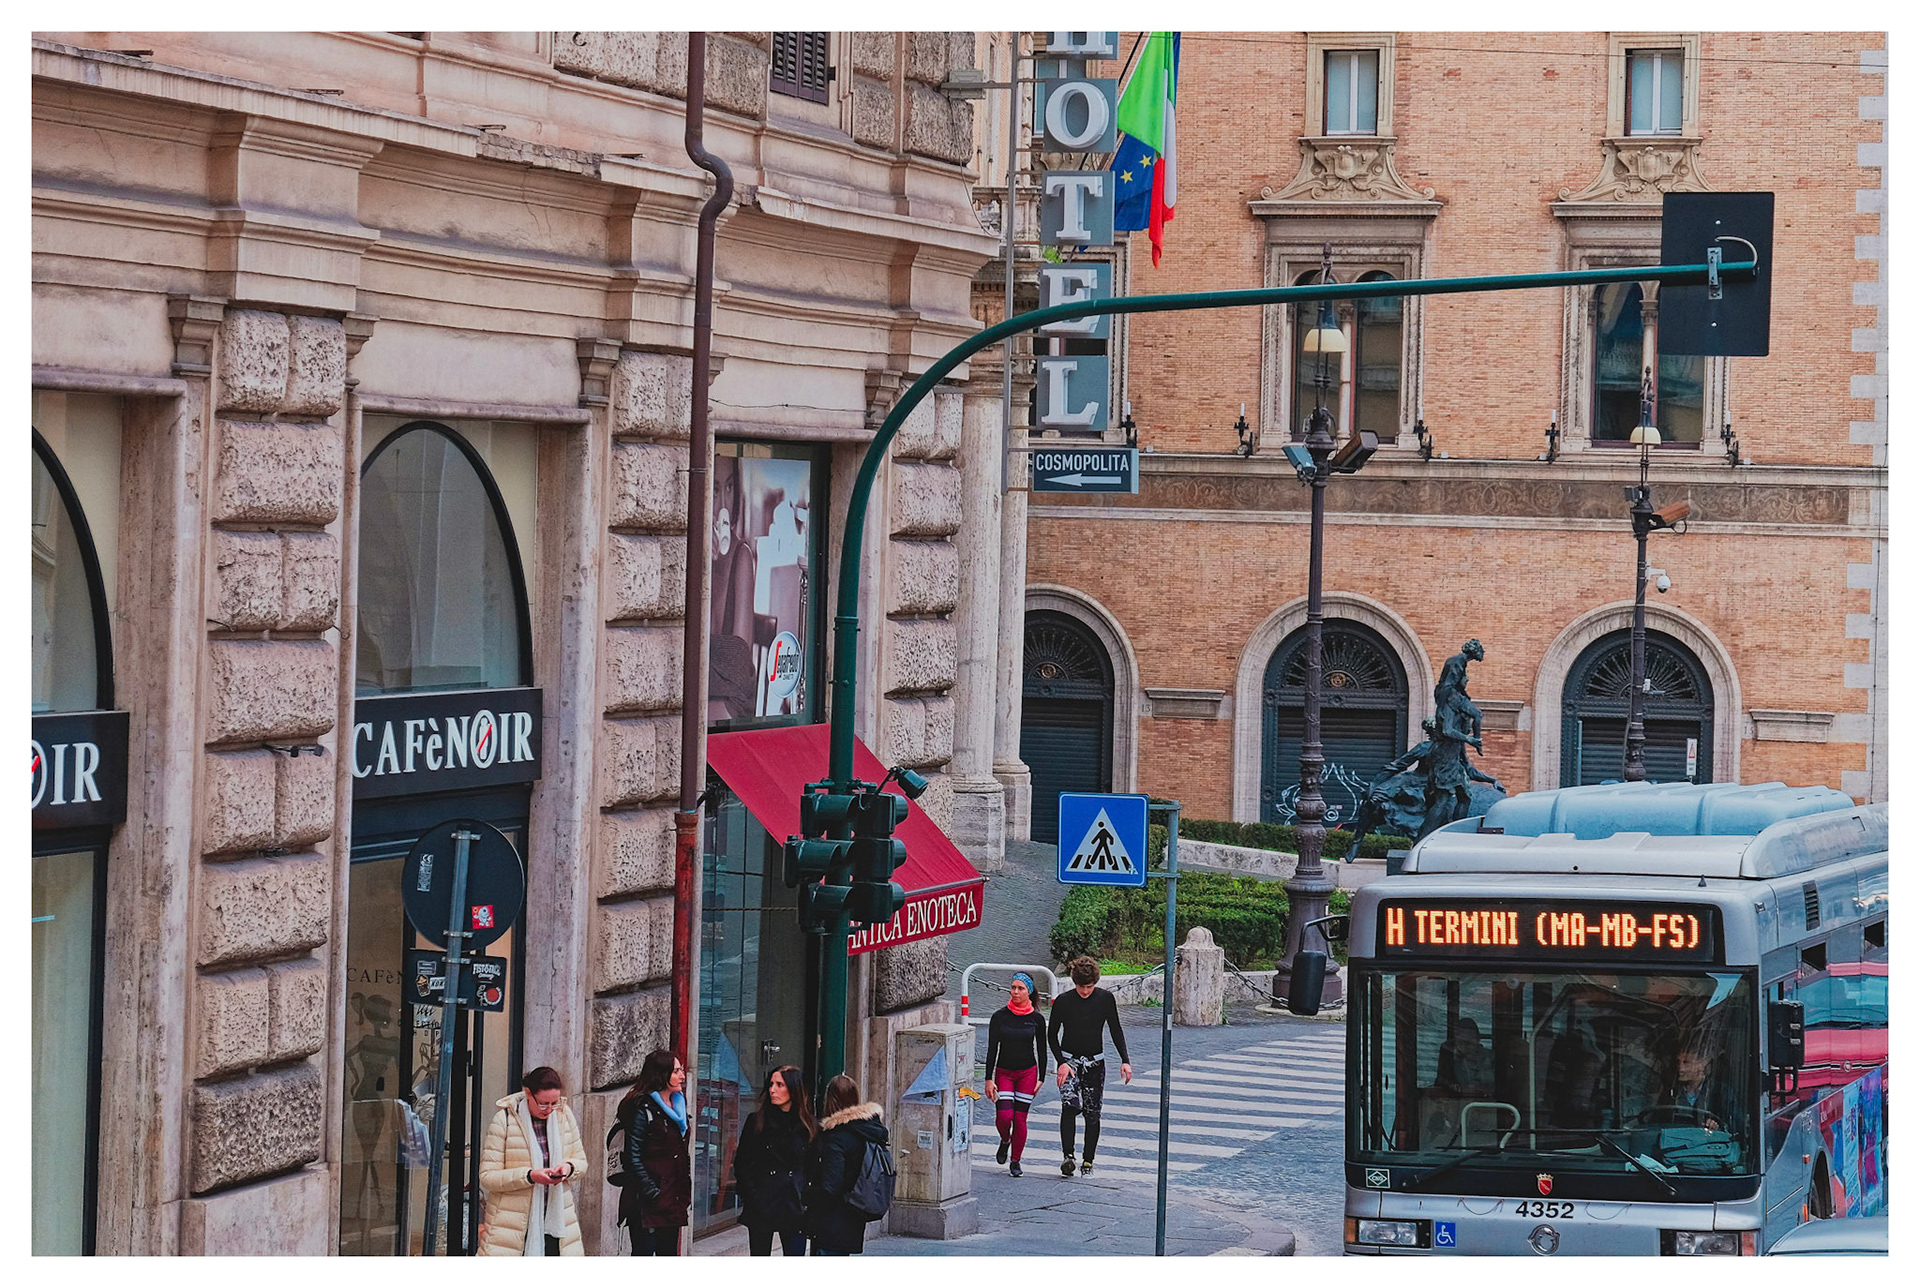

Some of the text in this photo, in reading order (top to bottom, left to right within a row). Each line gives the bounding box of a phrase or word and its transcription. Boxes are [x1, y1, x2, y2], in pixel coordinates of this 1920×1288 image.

[1036, 453, 1130, 471] COSMOPOLITA
[351, 709, 535, 778] CAFèNOIR
[906, 890, 977, 937] ENOTECA
[1386, 907, 1699, 949] H TERMINI (MA-MB-FS)
[1515, 1200, 1575, 1220] 4352
